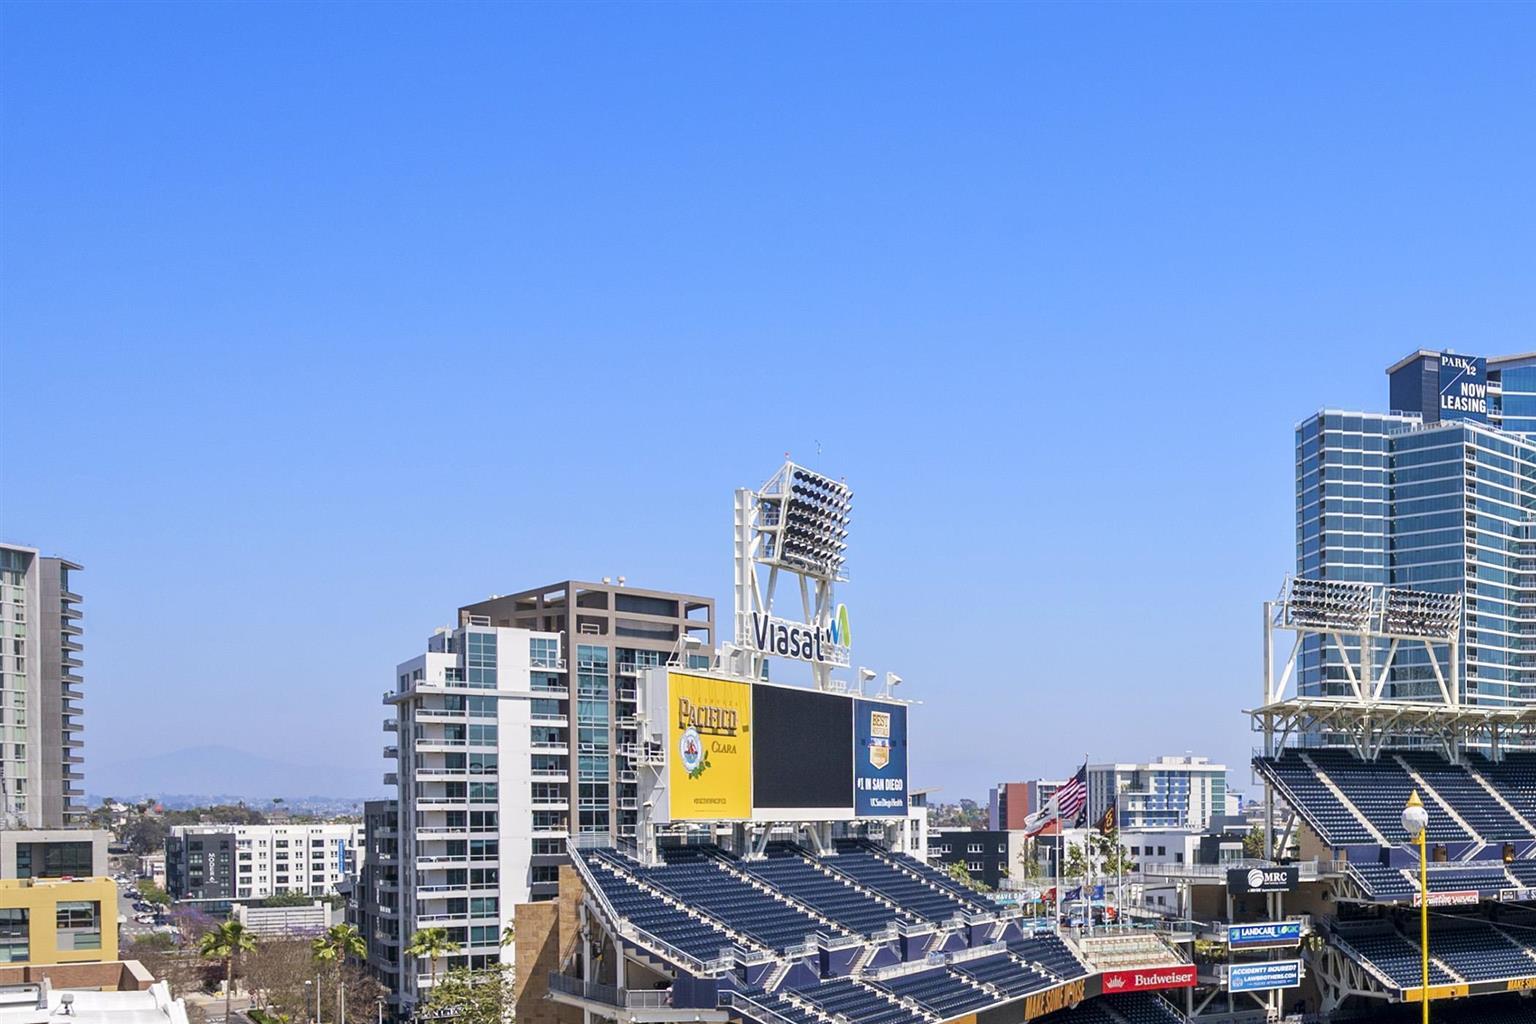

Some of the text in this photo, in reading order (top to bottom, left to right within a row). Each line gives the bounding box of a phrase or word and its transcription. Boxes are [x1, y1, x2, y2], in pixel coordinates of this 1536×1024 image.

[1461, 382, 1486, 398] NOW
[1441, 395, 1487, 413] LEASING
[753, 611, 825, 662] Viasat
[865, 777, 872, 790] IN
[872, 777, 885, 791] SAN
[885, 778, 904, 791] DIEGO
[1264, 872, 1288, 882] MRC
[1134, 972, 1193, 986] Budweiser
